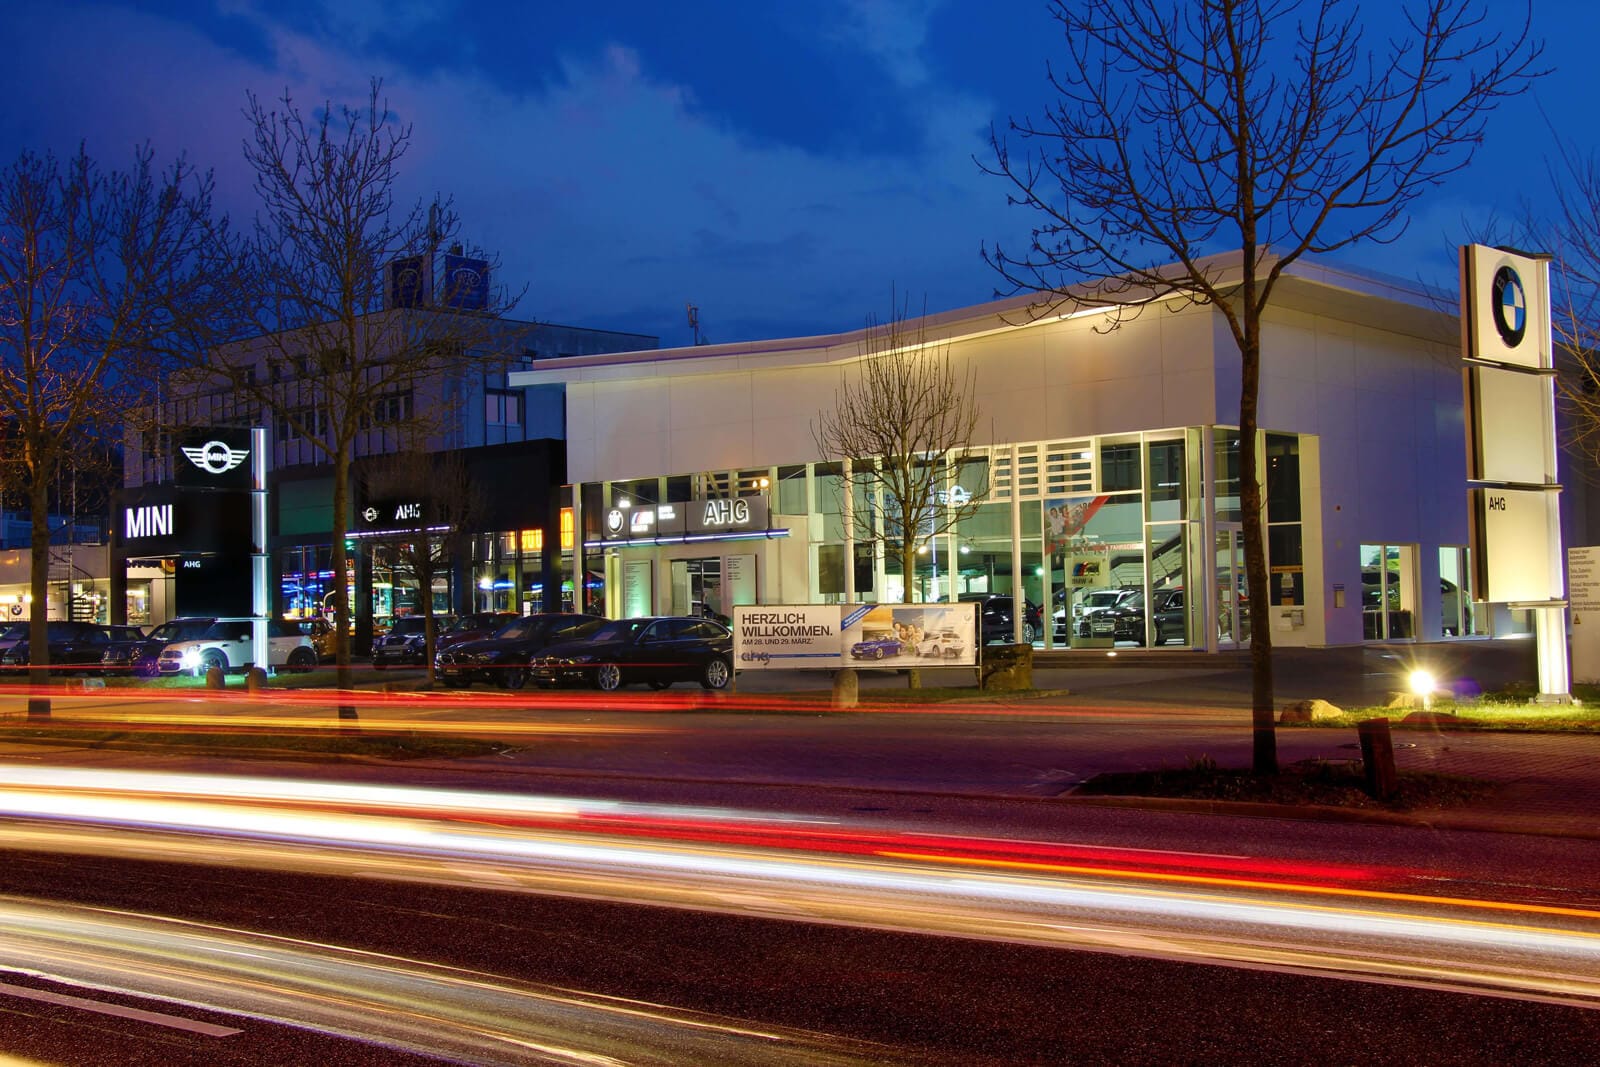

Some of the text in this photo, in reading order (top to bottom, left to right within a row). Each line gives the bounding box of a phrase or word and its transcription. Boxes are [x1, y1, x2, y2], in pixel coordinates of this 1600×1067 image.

[208, 452, 229, 462] MINI
[1489, 496, 1506, 511] AHG
[395, 503, 420, 520] AHG
[703, 499, 749, 526] AHG
[126, 504, 173, 539] MINI
[183, 560, 201, 568] AHG
[742, 613, 806, 625] HERZLICH
[742, 625, 833, 637] WILLKOMMEN.
